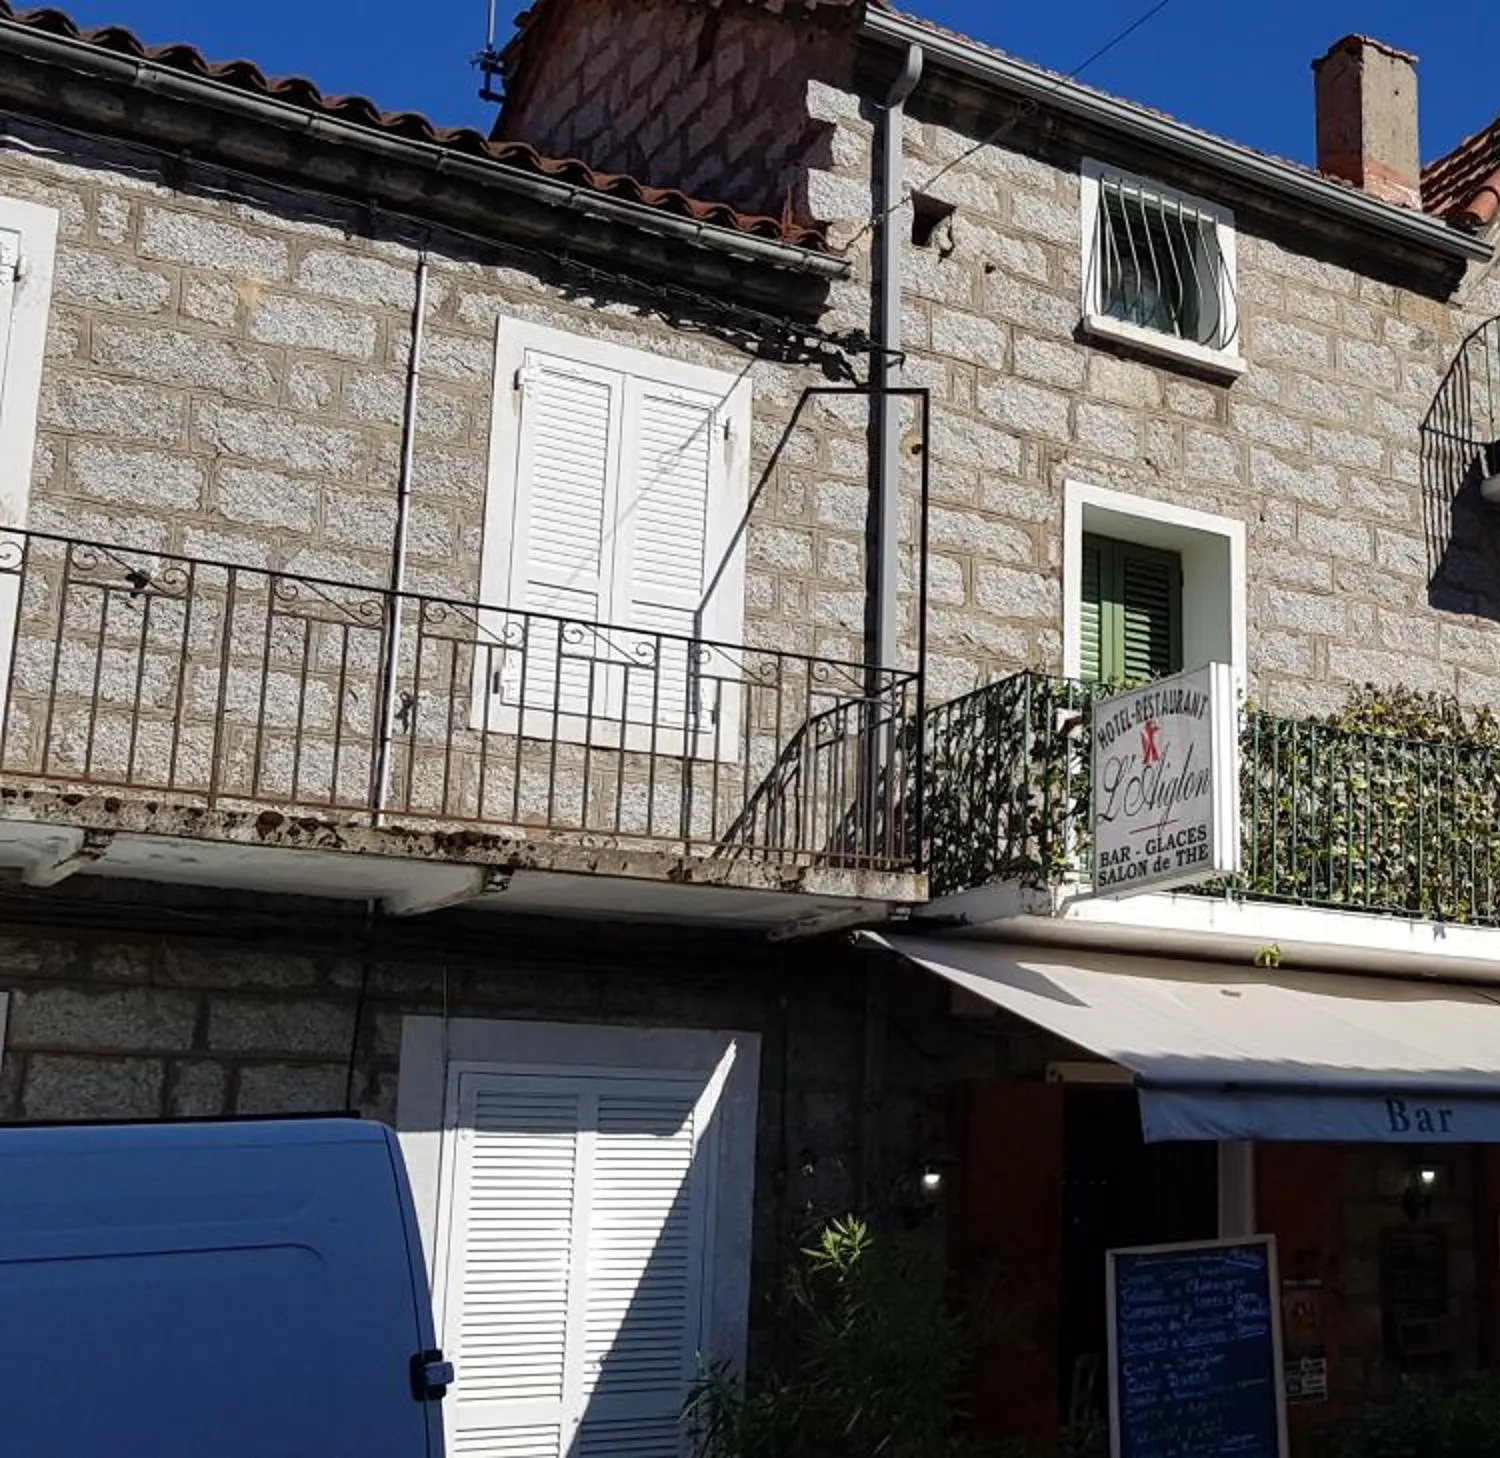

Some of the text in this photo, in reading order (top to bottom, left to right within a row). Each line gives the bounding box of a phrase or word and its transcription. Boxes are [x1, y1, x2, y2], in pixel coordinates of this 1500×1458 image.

[1097, 742, 1209, 836] L'Aiglon
[1098, 843, 1209, 886] SALON de THE
[1101, 846, 1131, 868] BAR
[1145, 825, 1207, 856] GLACES
[1384, 1099, 1454, 1134] Bar
